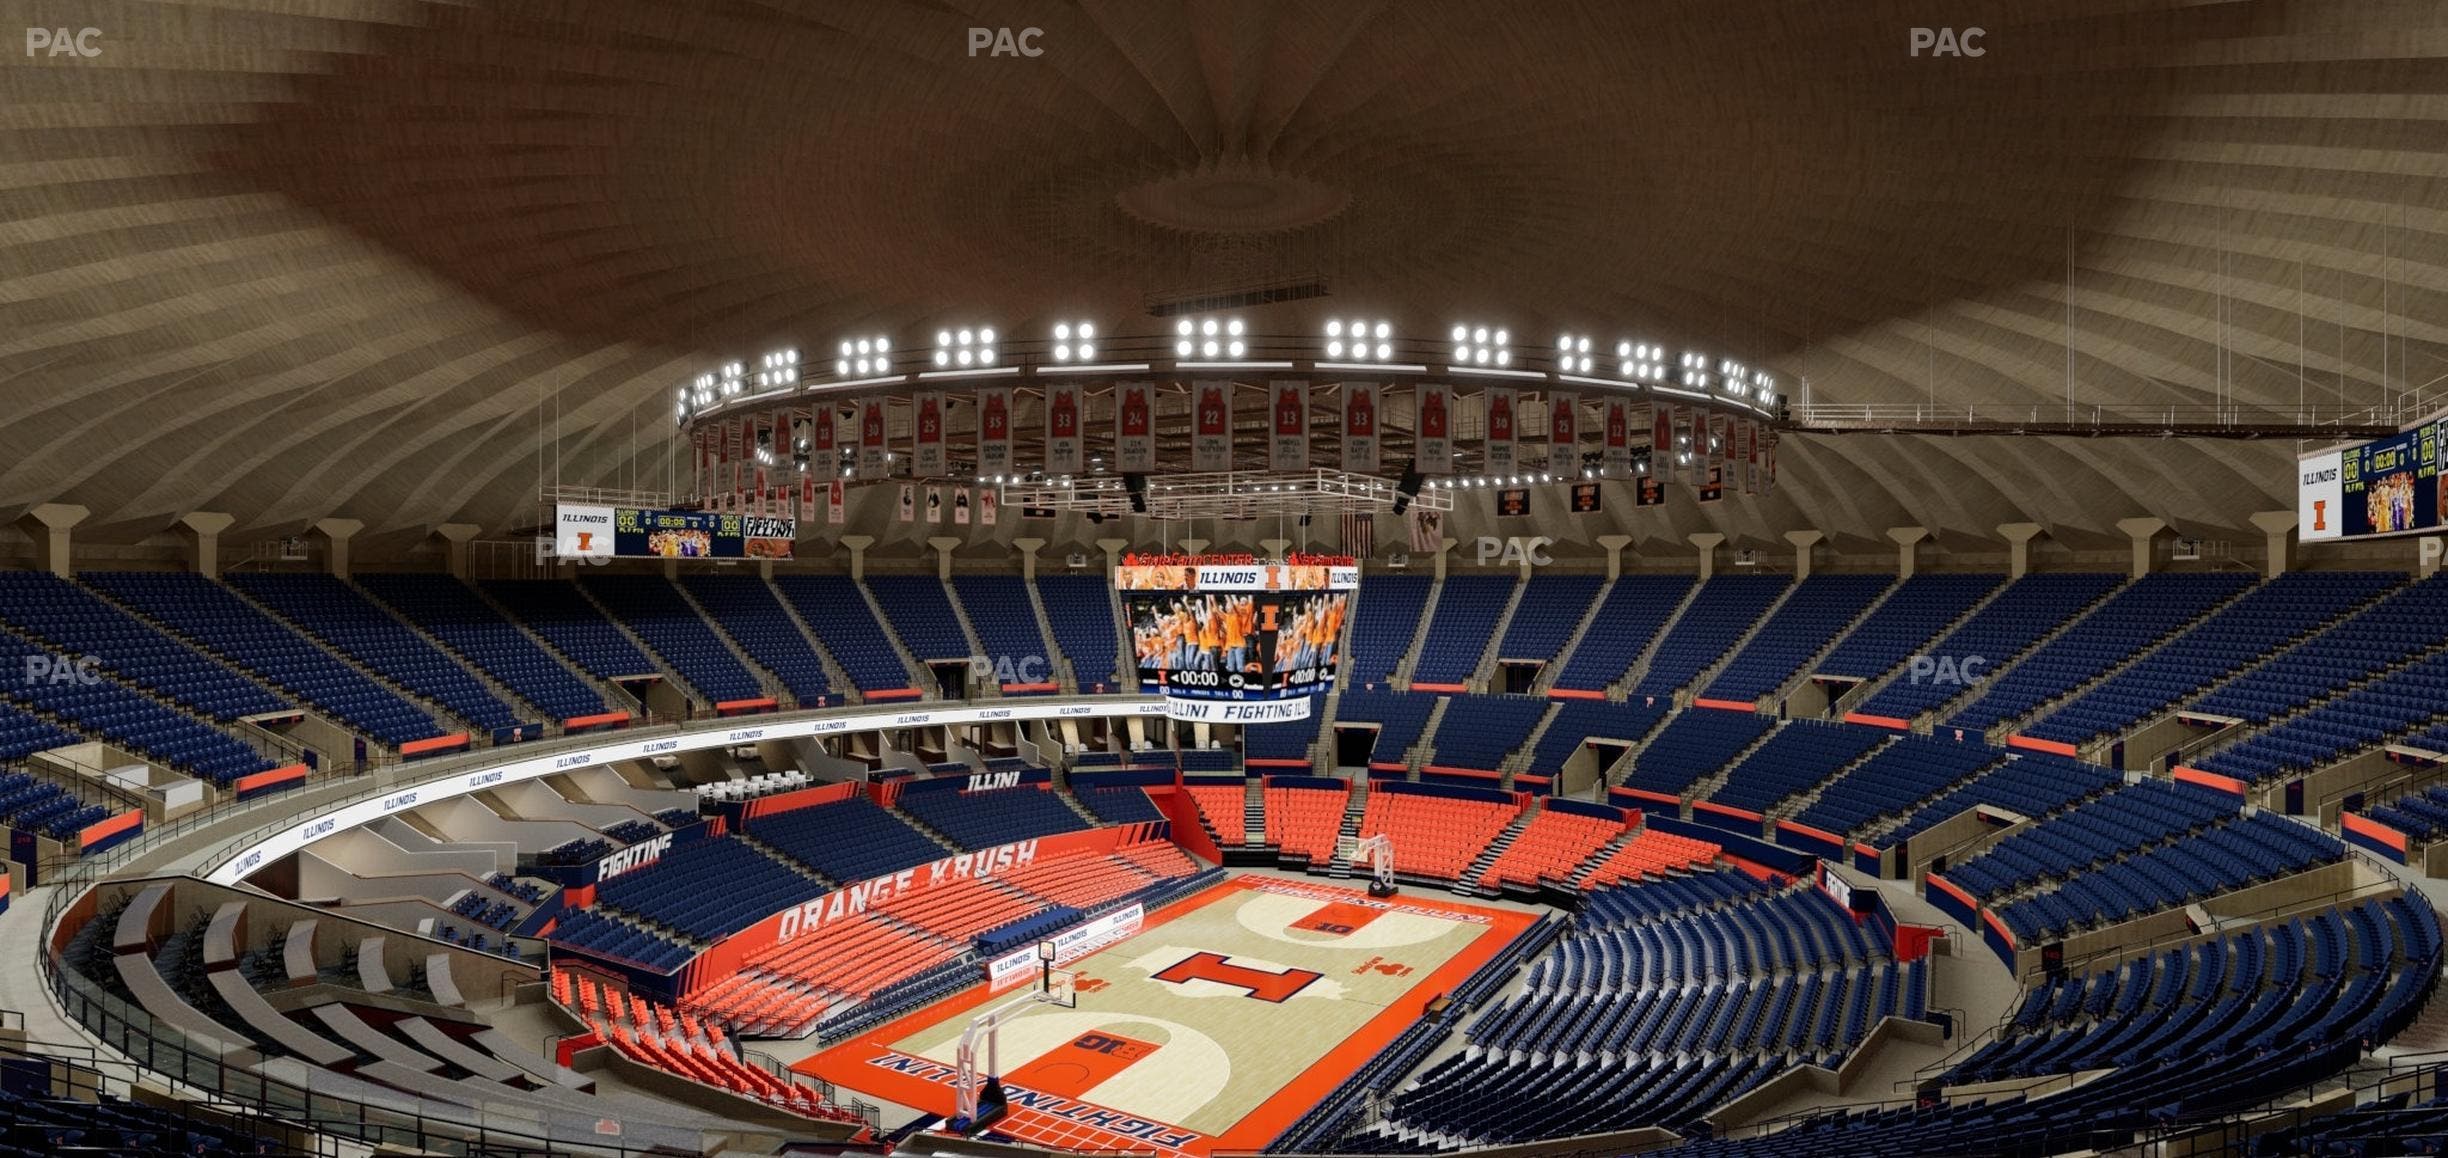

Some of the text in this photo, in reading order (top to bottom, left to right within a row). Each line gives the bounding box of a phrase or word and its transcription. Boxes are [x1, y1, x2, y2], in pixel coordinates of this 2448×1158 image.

[2375, 450, 2395, 470] 00:00
[2303, 468, 2337, 486] ILLINOIS
[2345, 461, 2358, 482] 00
[562, 514, 608, 524] ILLINOIS
[619, 517, 635, 526] 00
[659, 517, 685, 527] 00:00
[724, 521, 739, 530] 00
[1200, 573, 1257, 584] ILLINOIS
[1331, 573, 1358, 583] ILLINOIS
[1181, 671, 1218, 686] 00:00
[1294, 668, 1316, 684] 00:00
[1160, 686, 1170, 695] 00
[1232, 690, 1243, 699] 00
[978, 710, 1011, 718] ILLINOIS
[1059, 707, 1091, 715] ILLINOIS
[1224, 703, 1293, 719] FIGHTING
[814, 721, 847, 731] ILLINOIS
[897, 715, 929, 723] ILLINOIS
[729, 730, 763, 741] ILLINOIS
[643, 740, 678, 752] ILLINOIS
[556, 754, 591, 768] ILLINOIS
[469, 771, 502, 787] ILLINOIS
[968, 771, 1020, 791] ILLINI
[384, 792, 417, 811] ILLINOIS
[303, 818, 335, 840] ILLINOIS
[234, 850, 261, 876] ILLINOIS
[598, 833, 673, 882] FIGHTING
[777, 839, 1039, 945] ORANGE KRUSH
[1113, 908, 1139, 925] ILLINOIS
[1058, 929, 1087, 947] ILLINOIS
[997, 952, 1032, 972] ILLINOIS
[1001, 1084, 1203, 1150] FIGHTING
